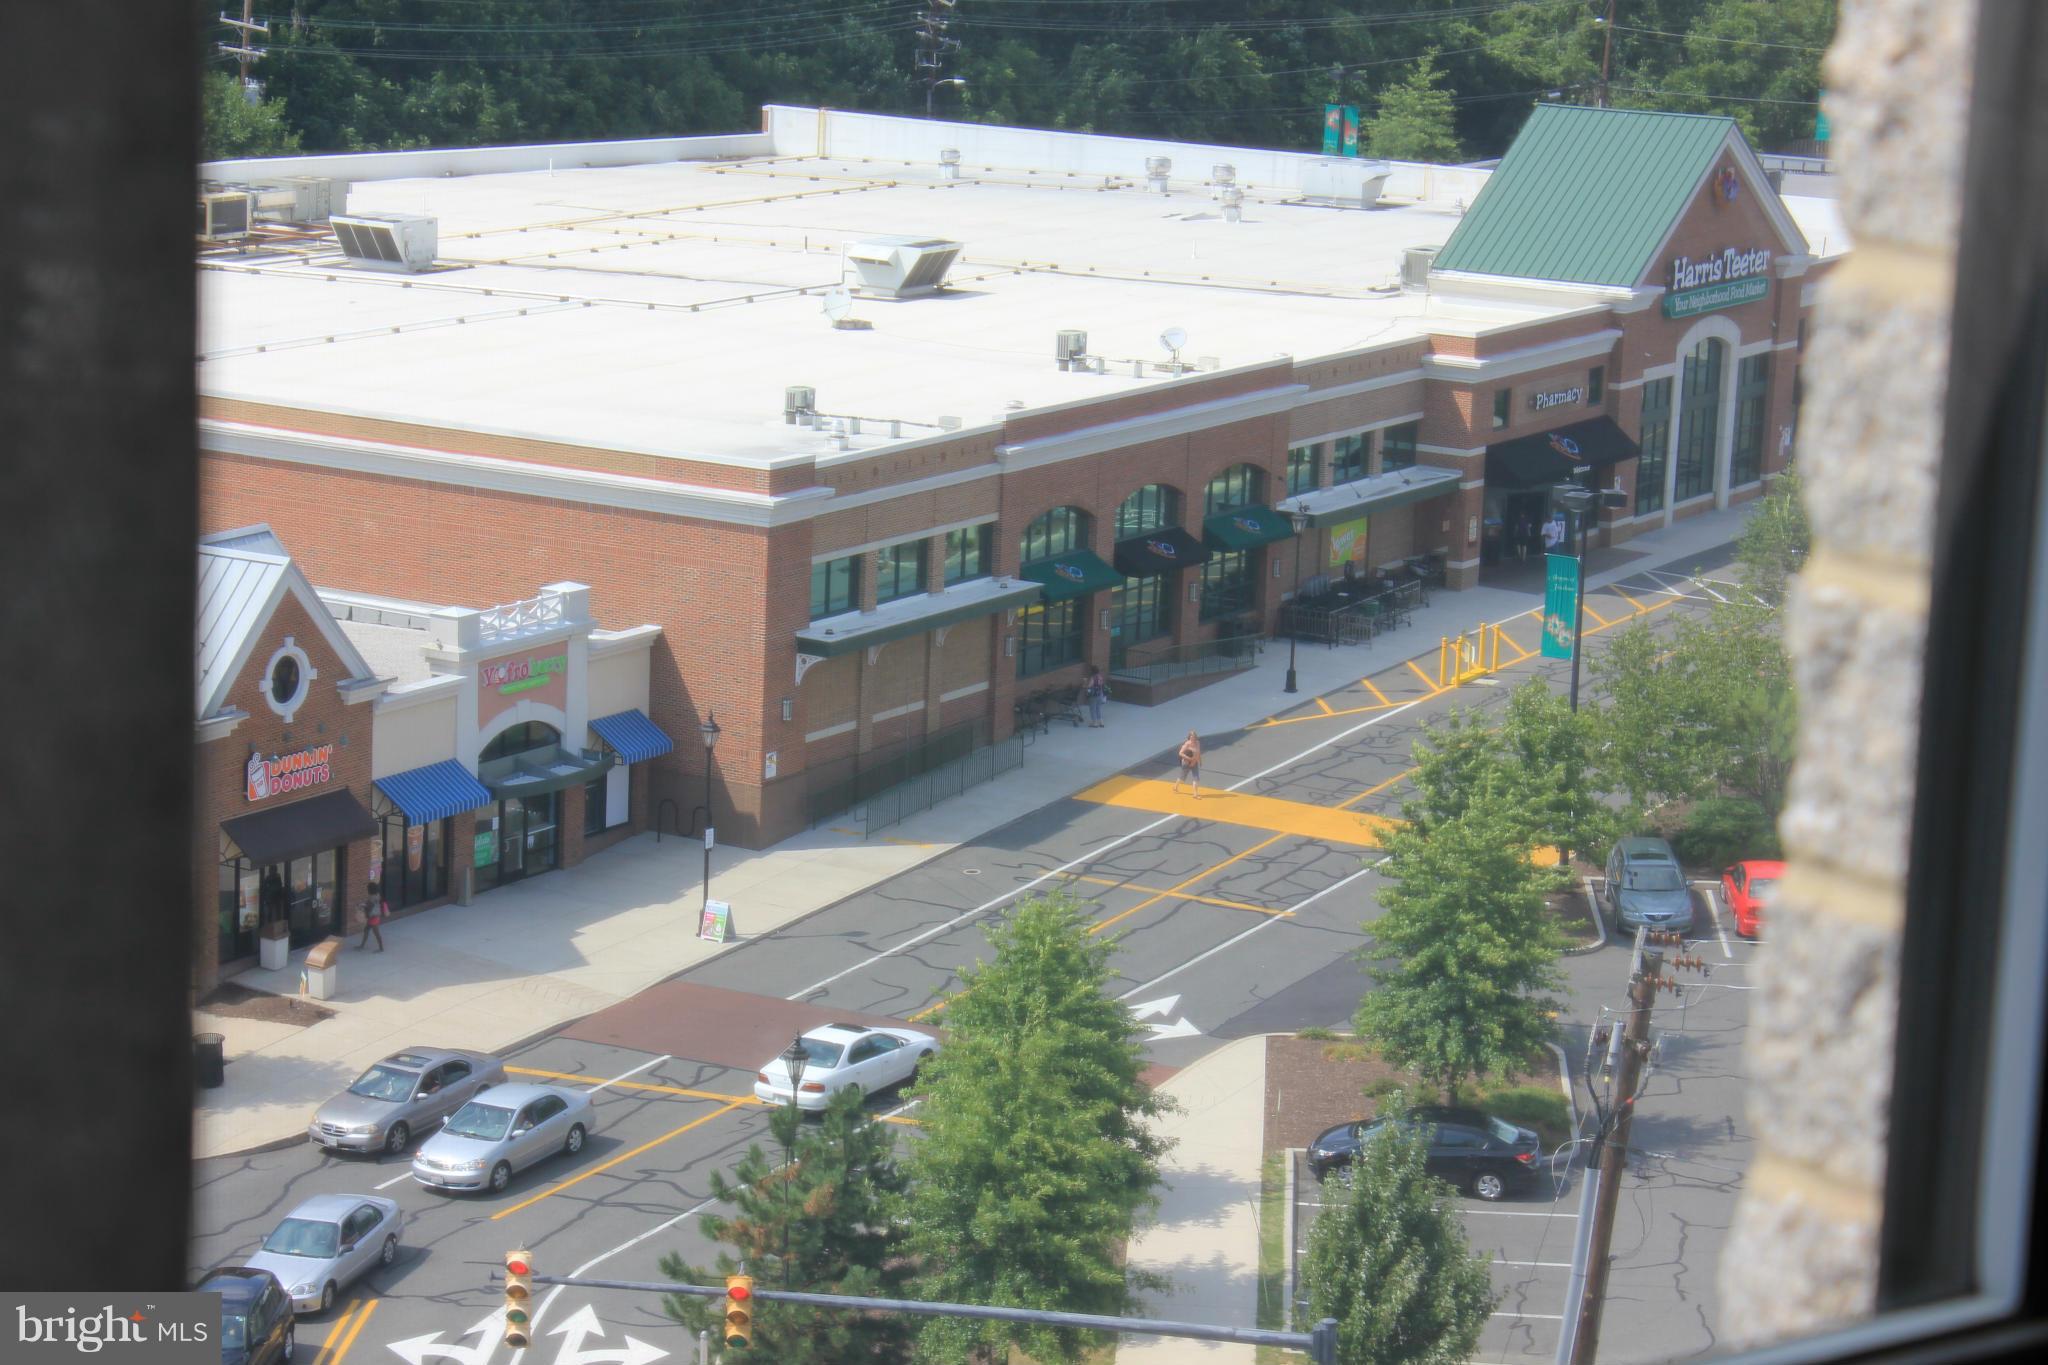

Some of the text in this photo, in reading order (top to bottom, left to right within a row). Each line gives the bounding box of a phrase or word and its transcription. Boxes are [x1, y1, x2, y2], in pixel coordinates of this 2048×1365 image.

[1673, 247, 1770, 290] Harris Teeter
[1536, 387, 1583, 410] Pharmacy
[271, 764, 329, 795] DONUTS
